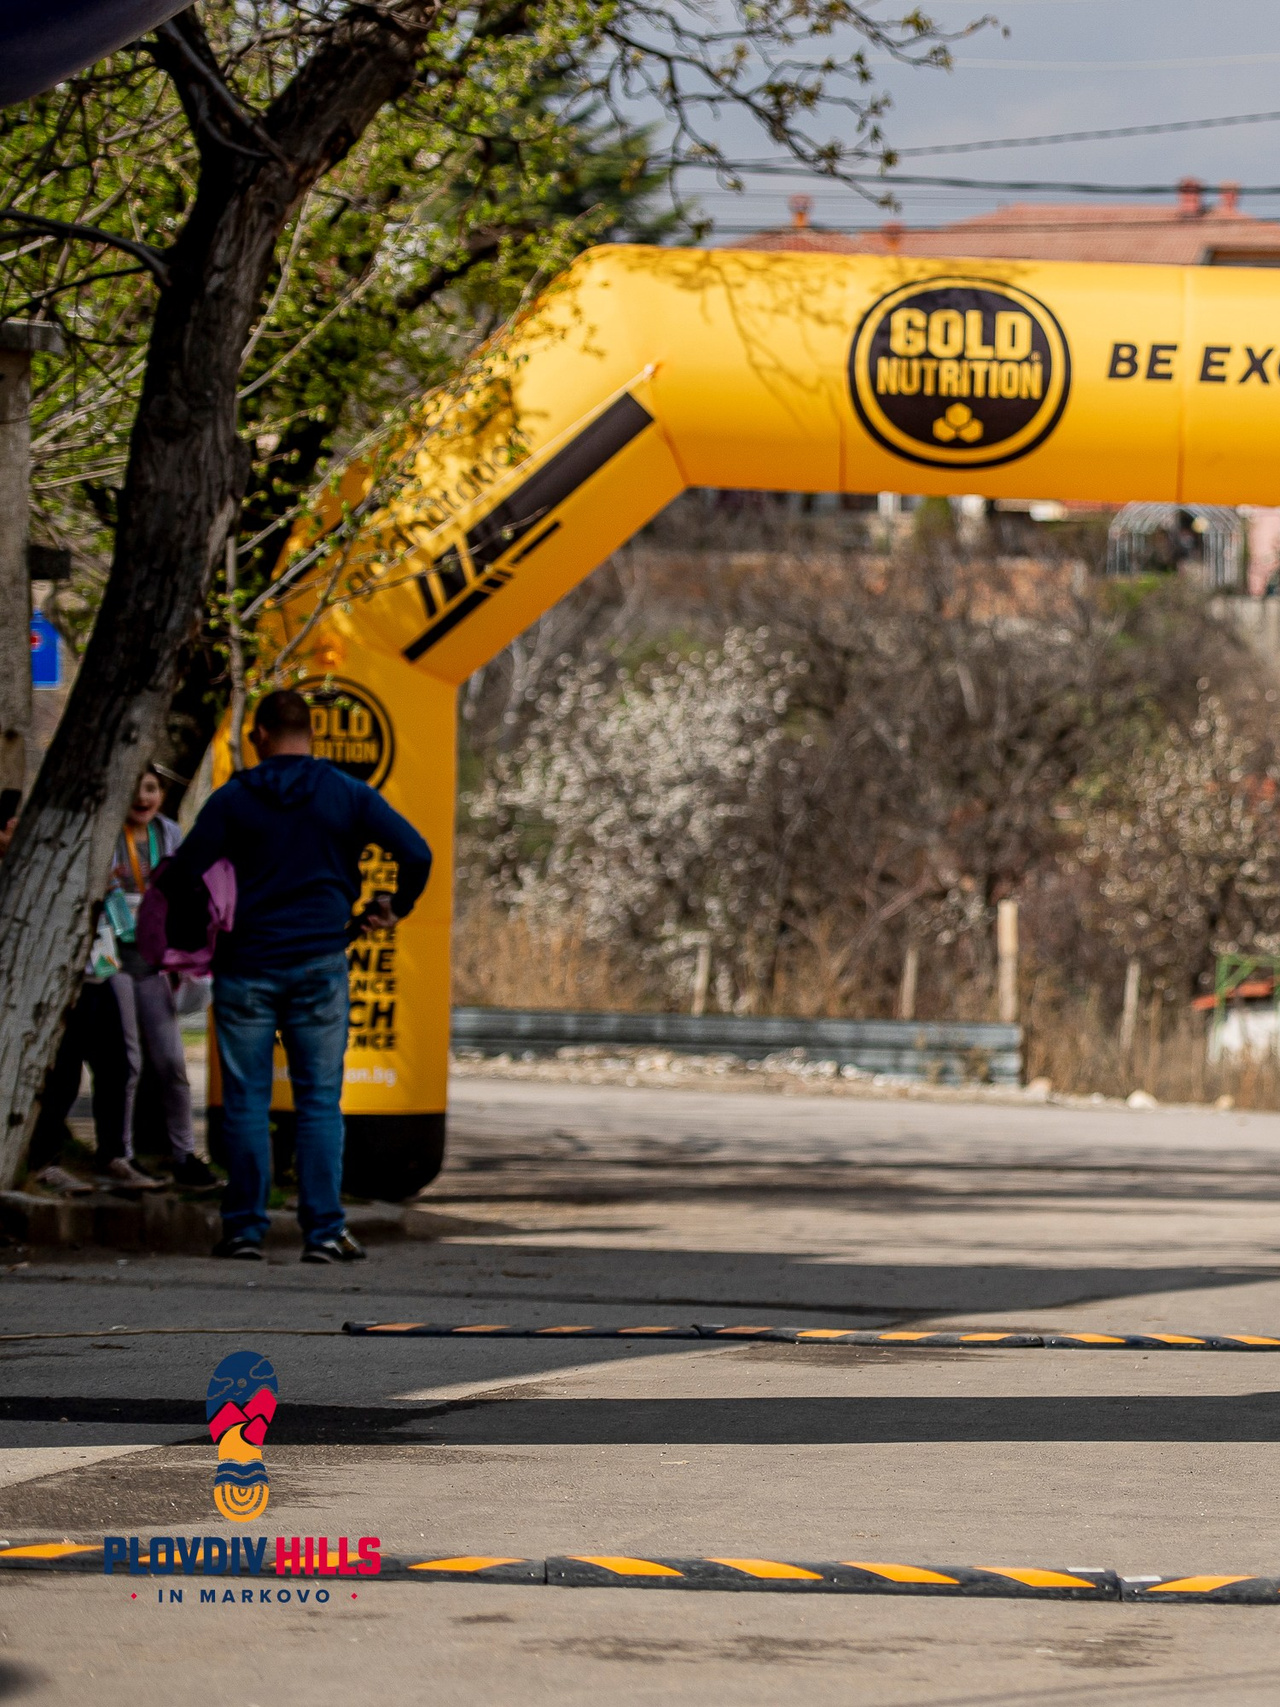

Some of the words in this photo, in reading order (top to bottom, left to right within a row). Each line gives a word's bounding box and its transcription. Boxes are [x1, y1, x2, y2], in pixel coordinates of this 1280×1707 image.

[890, 307, 1033, 361] GOLD
[876, 356, 1043, 400] NUTRITION
[1107, 343, 1178, 380] BE
[309, 706, 372, 738] OLD
